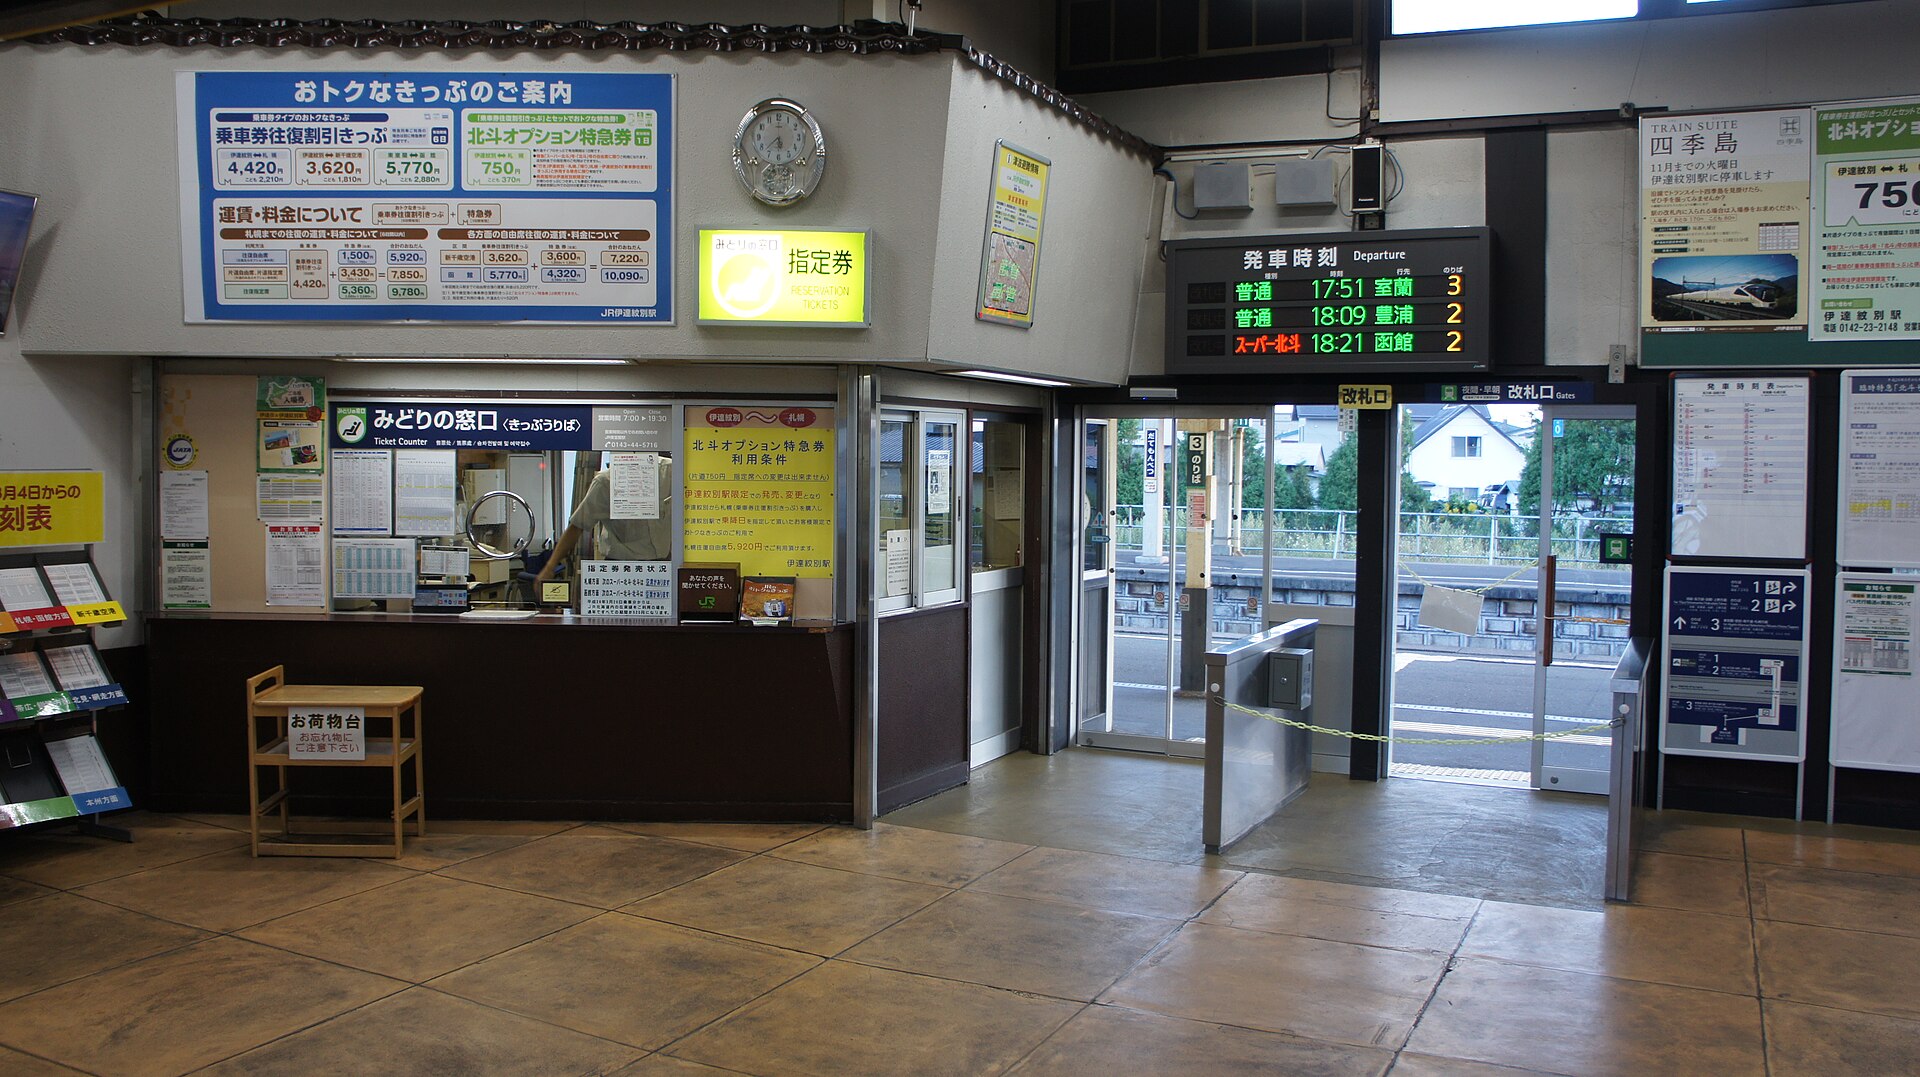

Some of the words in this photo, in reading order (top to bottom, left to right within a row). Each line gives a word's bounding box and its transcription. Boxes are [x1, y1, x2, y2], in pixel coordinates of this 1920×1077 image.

[294, 80, 572, 104] おトクなきっぷのご案内
[252, 113, 350, 122] 乗車券タイプのおトクなきっぷ
[1650, 122, 1692, 134] TRAIN
[1698, 119, 1738, 131] SUITE
[215, 127, 388, 145] 乗車券往復割引きっぷ
[467, 127, 631, 145] 北斗オプション特急券
[1650, 131, 1738, 156] 四季島
[228, 161, 284, 175] 4,420円
[306, 161, 362, 175] 3,620円
[386, 161, 440, 175] 5,770円
[481, 161, 521, 175] 750円
[1650, 159, 1738, 173] 11月までの火曜日
[1837, 164, 1876, 176] 伊達紋別
[1650, 169, 1774, 186] 伊達紋別駅に停車します
[219, 205, 362, 224] 運賃・料金について
[377, 210, 444, 218] 乗車券往復割引きっぷ
[467, 209, 492, 218] 特急券
[245, 229, 378, 239] 札幌までの往復の運賃・料金について
[467, 230, 620, 241] 各方面の自由席往復の運賃・料金について
[390, 252, 423, 262] 5,920円
[488, 253, 523, 263] 3,620円
[546, 252, 581, 262] 3,600円
[610, 254, 644, 264] 7,220円
[788, 248, 853, 275] 指定券
[1243, 246, 1338, 270] 発車時刻
[1353, 250, 1406, 263] Departure
[341, 268, 374, 278] 3,430円
[391, 270, 424, 280] 7,850円
[546, 269, 581, 279] 4,320円
[1329, 270, 1344, 278] 時刻
[1443, 265, 1464, 274] のりば
[489, 270, 523, 281] 5,770円
[604, 271, 644, 281] 10,090円
[1264, 272, 1278, 280] 種別
[293, 279, 326, 289] 4,420円
[1235, 281, 1272, 301] 普通
[1311, 278, 1365, 299] 17:51
[1374, 277, 1413, 297] 室蘭
[1447, 274, 1462, 295] 3
[341, 285, 375, 295] 5,360円
[391, 287, 424, 297] 9,780円
[791, 285, 849, 296] RESERVATION
[803, 300, 839, 310] TICKETS
[601, 308, 657, 318] JR伊達紋別駅
[1235, 307, 1272, 328] 普通
[1311, 305, 1367, 326] 18:09
[1374, 304, 1413, 326] 豊浦
[1446, 302, 1462, 324] 2
[1824, 310, 1902, 321] 伊達紋別駅
[1823, 323, 1837, 333] 電話
[1839, 322, 1898, 332] 0142-23-2148
[1235, 333, 1301, 354] スーパー北斗
[1311, 332, 1363, 353] 18:21
[1374, 331, 1413, 353] 函館
[1446, 330, 1462, 352] 2
[1461, 385, 1501, 394] 夜間・早朝
[1707, 382, 1775, 390] 発車時刻表
[1342, 388, 1388, 405] 改札口
[1507, 384, 1555, 400] 改札口
[1555, 391, 1576, 400] Gates
[337, 407, 367, 415] みどりの窓口
[373, 408, 498, 431] みどりの窓口
[709, 413, 741, 422] 伊達紋別
[788, 413, 805, 422] 札幌
[374, 437, 396, 446] Ticket
[398, 437, 428, 446] Counter
[692, 439, 825, 452] 北斗オプション特急券
[1192, 436, 1202, 449] 3
[1146, 430, 1156, 476] だてもんべつ
[732, 454, 787, 465] 利用条件
[0, 504, 52, 531] 刻表
[587, 564, 667, 573] 指定券発売状況
[787, 559, 831, 568] 伊達紋別駅
[681, 582, 733, 590] 聞かせてください。
[1752, 581, 1760, 593] 1
[698, 596, 716, 606] JR
[1750, 599, 1760, 612] 2
[76, 607, 117, 618] 新千歳空港
[14, 612, 70, 625] 札幌・函館方面
[1710, 618, 1720, 631] 3
[1712, 665, 1719, 675] 2
[72, 690, 124, 704] 北見・網走方面
[1685, 701, 1693, 710] 3
[291, 713, 361, 730] お荷物台
[299, 732, 353, 743] お忘れ物に
[295, 742, 360, 753] ご注意下さい
[85, 795, 119, 807] 本州方面
